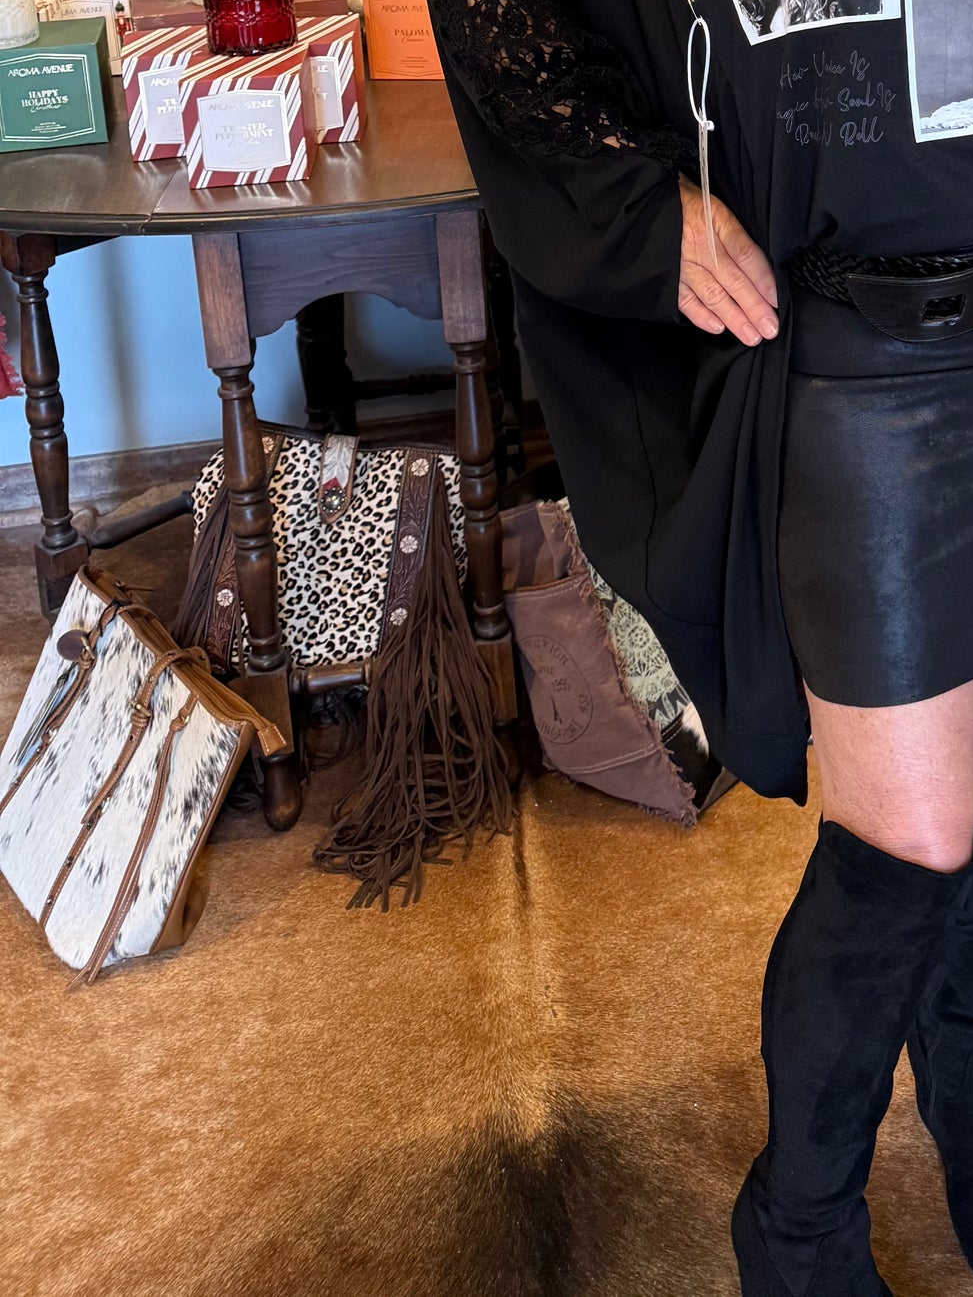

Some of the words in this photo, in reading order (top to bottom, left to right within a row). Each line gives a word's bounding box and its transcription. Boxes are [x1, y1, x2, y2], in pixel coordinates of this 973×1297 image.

[381, 4, 410, 13] AROMA
[394, 28, 430, 37] PALOMA
[8, 64, 40, 78] AROMA
[41, 63, 75, 74] AVENUE
[779, 62, 809, 90] Her
[812, 50, 846, 78] Voice
[849, 49, 871, 82] Is
[28, 88, 59, 99] HAPPY
[837, 81, 876, 112] Soul
[876, 82, 897, 113] Is
[21, 95, 69, 108] HOLIDAYS
[839, 116, 884, 147] Roll
